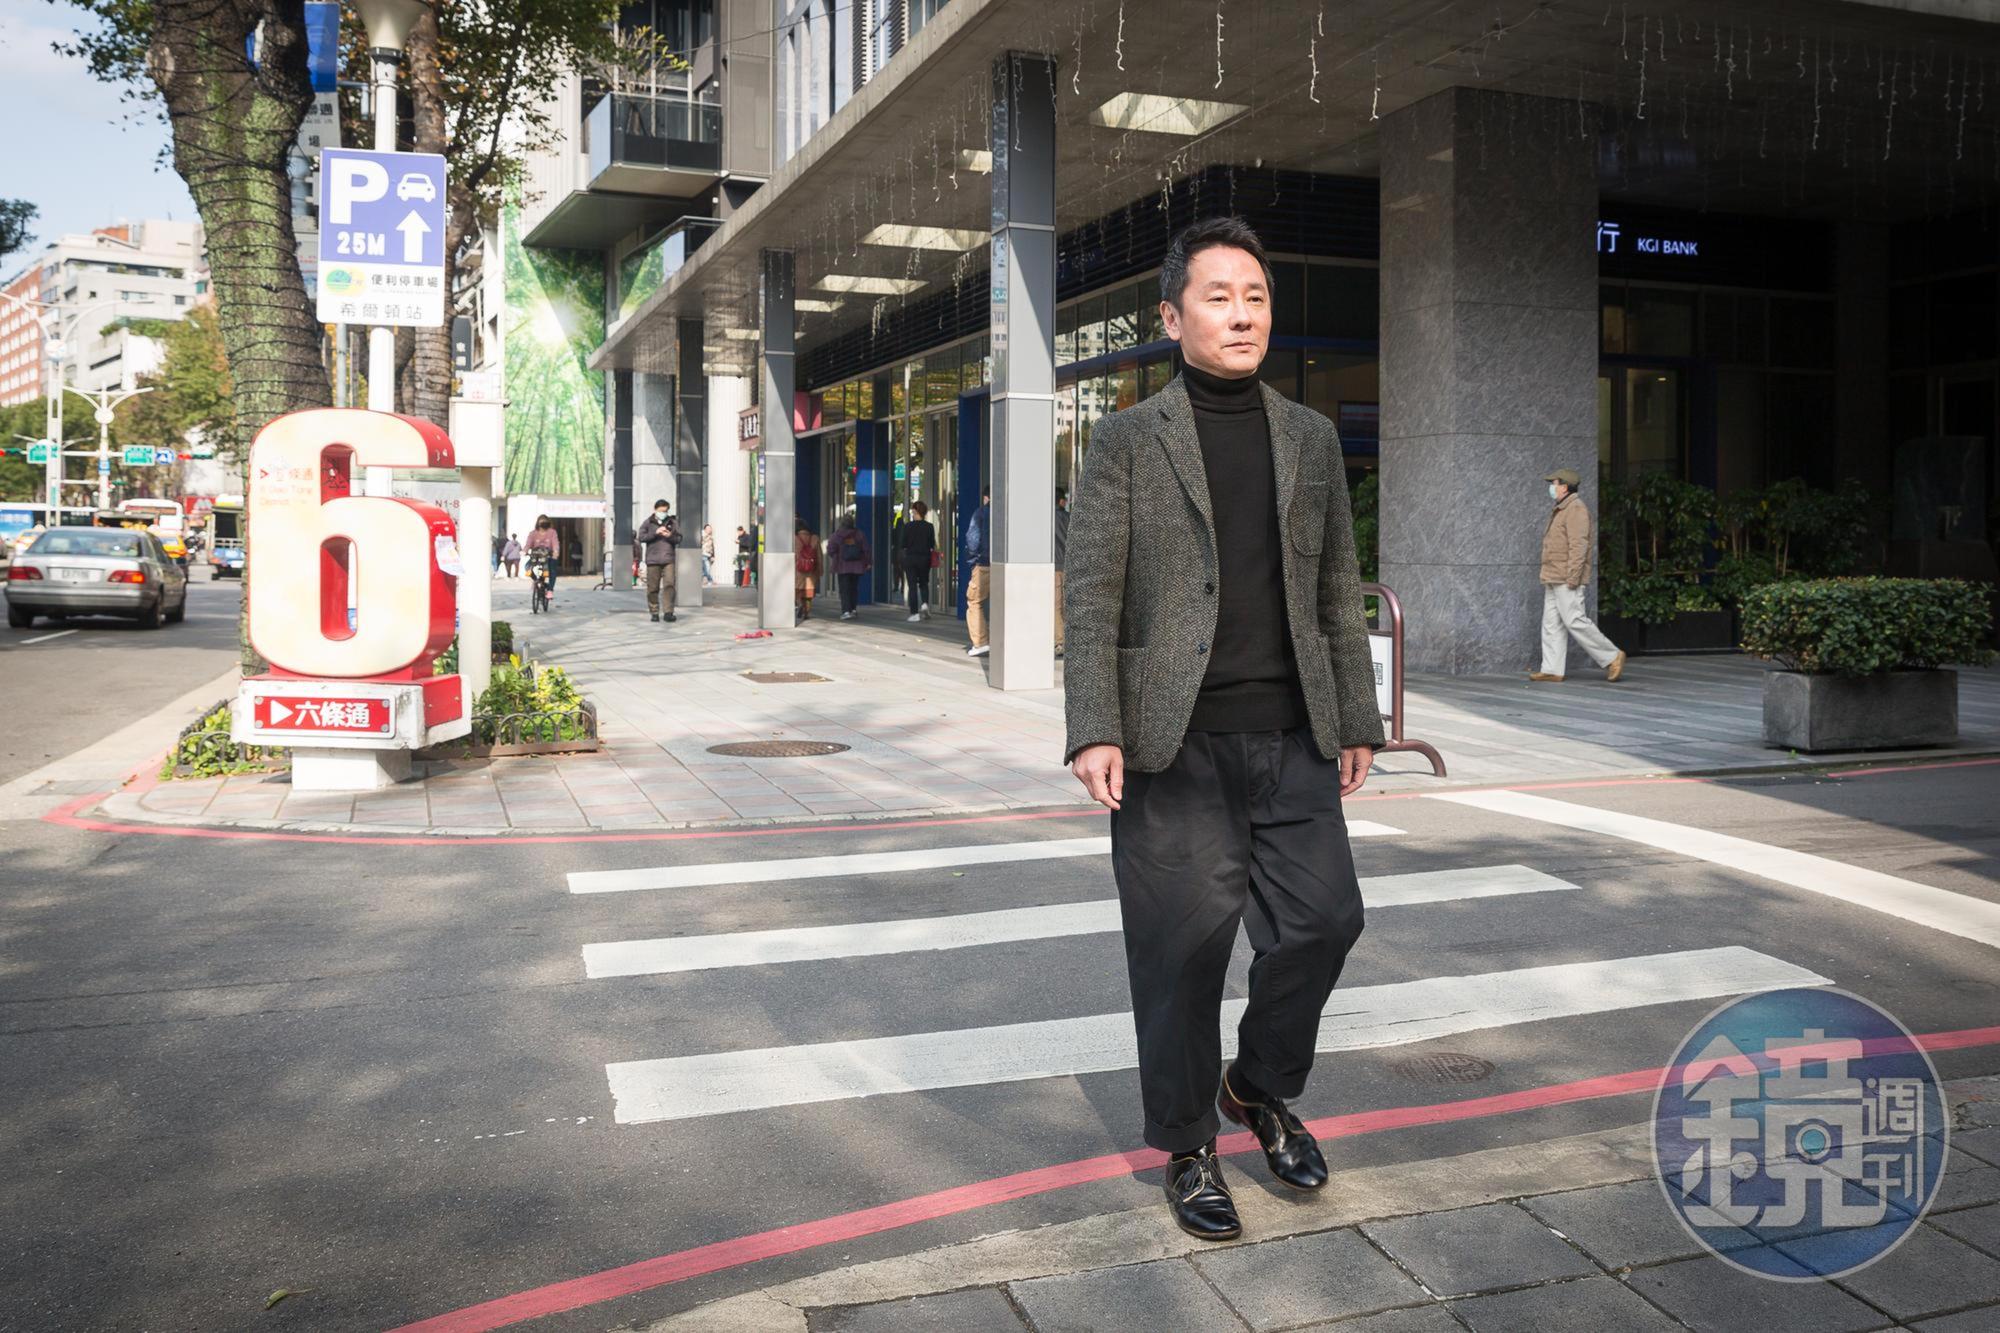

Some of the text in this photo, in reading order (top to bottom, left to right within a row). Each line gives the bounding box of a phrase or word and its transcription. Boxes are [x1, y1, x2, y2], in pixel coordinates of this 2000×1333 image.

[330, 158, 389, 225] P
[337, 231, 386, 256] 25M
[1597, 221, 1698, 256] 行 KGI BANK
[371, 273, 439, 288] 便利停車場
[340, 302, 423, 320] 希爾頓站
[249, 409, 456, 678] 6
[294, 700, 371, 728] 六條通
